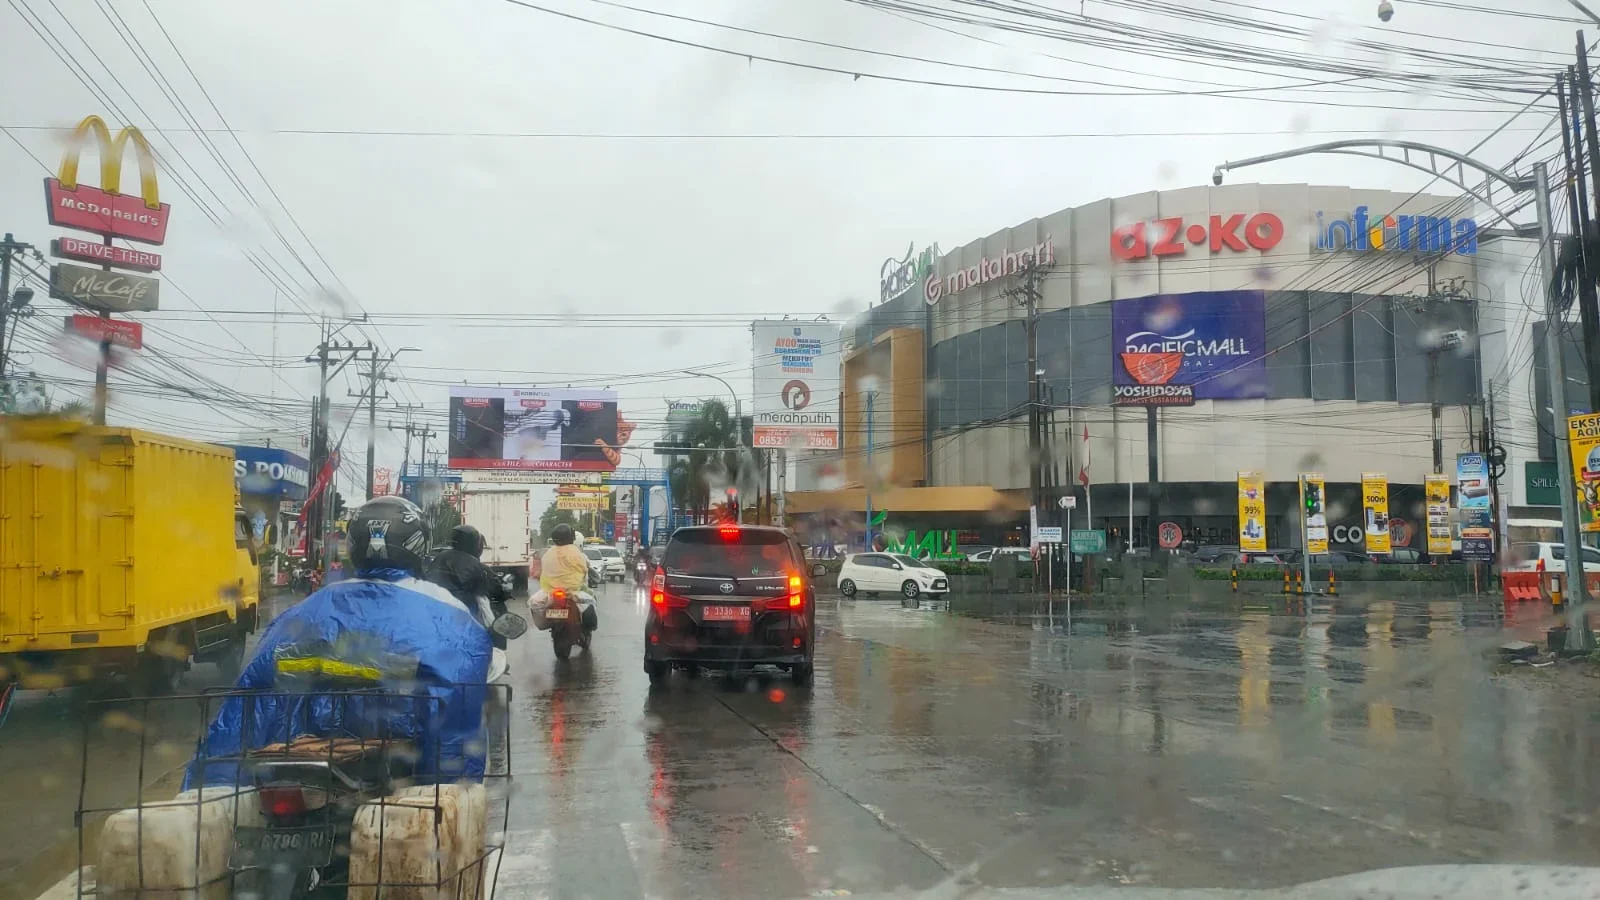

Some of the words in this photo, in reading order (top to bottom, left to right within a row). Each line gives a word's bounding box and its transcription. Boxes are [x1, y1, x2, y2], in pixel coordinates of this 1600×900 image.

[61, 197, 159, 226] McDonald's
[1316, 205, 1478, 256] informa
[66, 240, 113, 259] DRIVE
[120, 248, 160, 267] THRU
[947, 233, 1055, 295] matahari
[72, 276, 149, 303] McCafé
[1114, 385, 1193, 397] YOSHINOYA
[760, 412, 832, 424] merahputih
[759, 435, 782, 445] 0852
[1244, 506, 1261, 514] 99%
[886, 528, 968, 560] MALL
[1330, 525, 1363, 543] .CO
[703, 606, 709, 616] G
